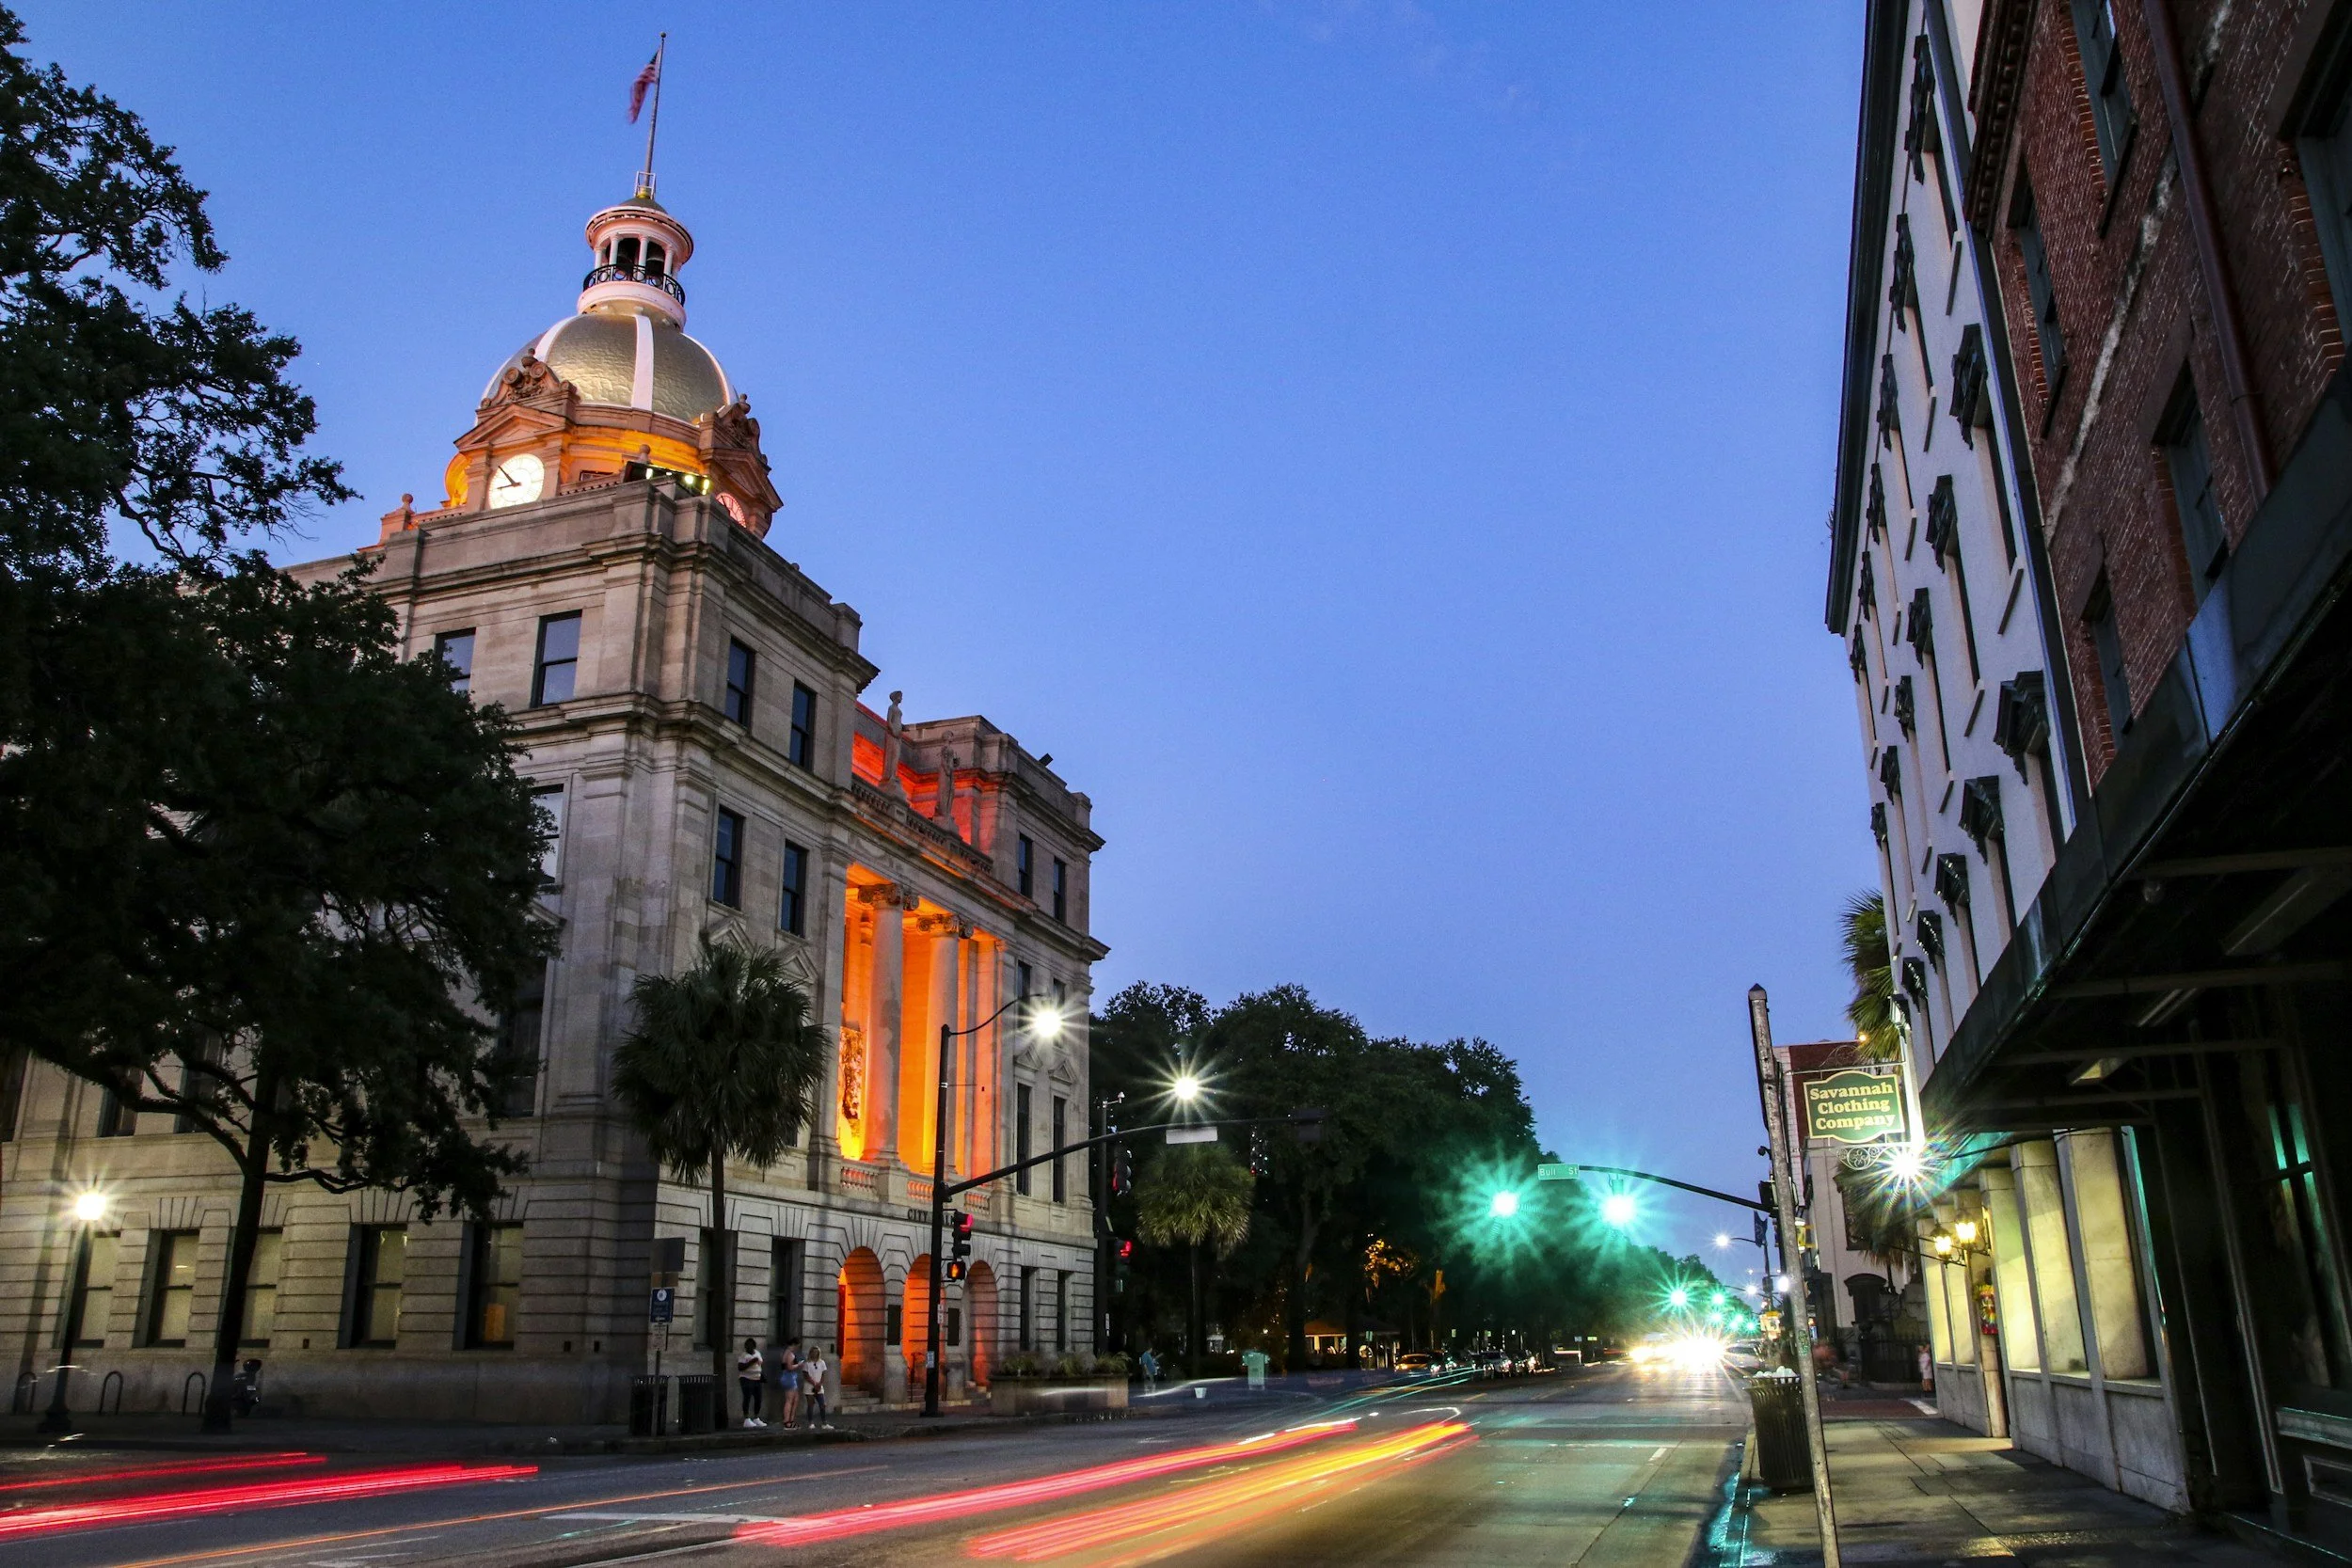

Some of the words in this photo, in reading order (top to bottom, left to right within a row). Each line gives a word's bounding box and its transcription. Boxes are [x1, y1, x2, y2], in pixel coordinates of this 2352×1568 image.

[1810, 1082, 1894, 1100] Savannah
[1817, 1098, 1890, 1115] Clothing
[1816, 1114, 1895, 1130] Company
[1539, 1167, 1556, 1177] Bull
[1568, 1166, 1578, 1175] St
[908, 1210, 928, 1223] CITY
